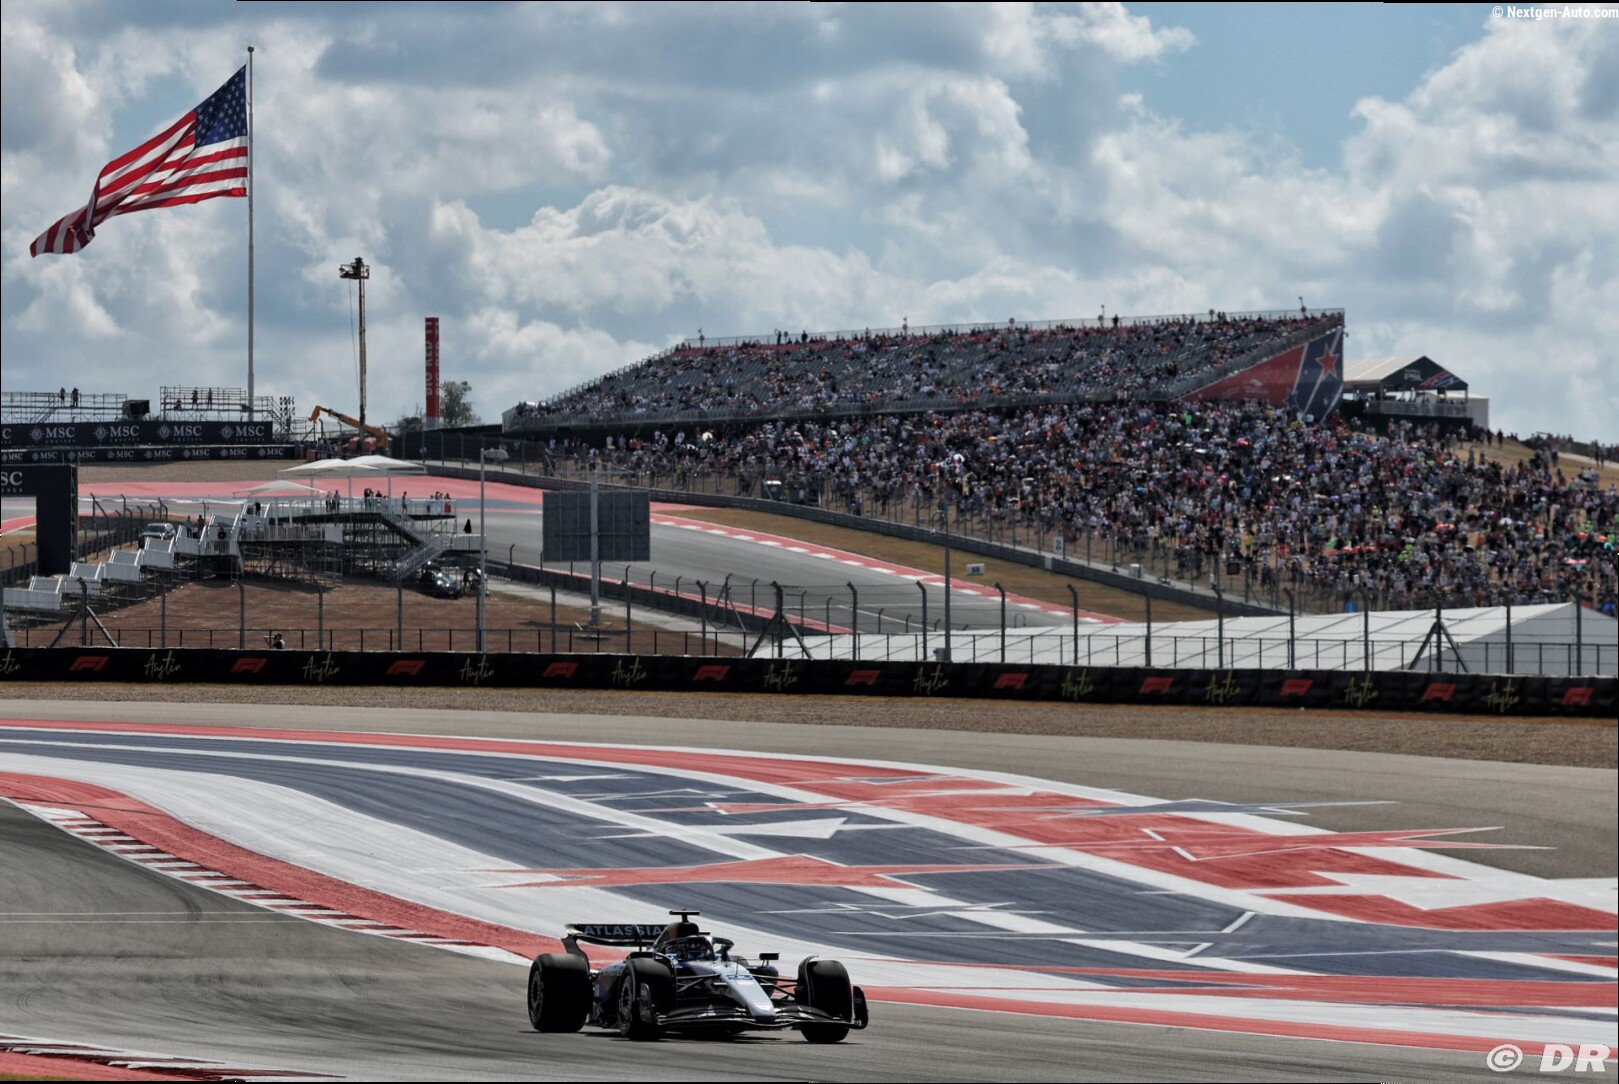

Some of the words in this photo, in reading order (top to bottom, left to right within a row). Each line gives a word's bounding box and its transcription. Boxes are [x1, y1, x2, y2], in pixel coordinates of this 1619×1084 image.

[45, 427, 76, 439] MSC
[109, 425, 140, 437] MSC
[173, 425, 203, 437] MSC
[235, 425, 265, 437] MSC
[8, 452, 23, 460] MSC
[40, 451, 58, 459] MSC
[78, 450, 97, 458] MSC
[116, 450, 134, 458] MSC
[153, 450, 173, 458] MSC
[191, 449, 210, 457] MSC
[229, 448, 248, 456] MSC
[266, 448, 285, 456] MSC
[583, 925, 665, 936] ATLASSIA
